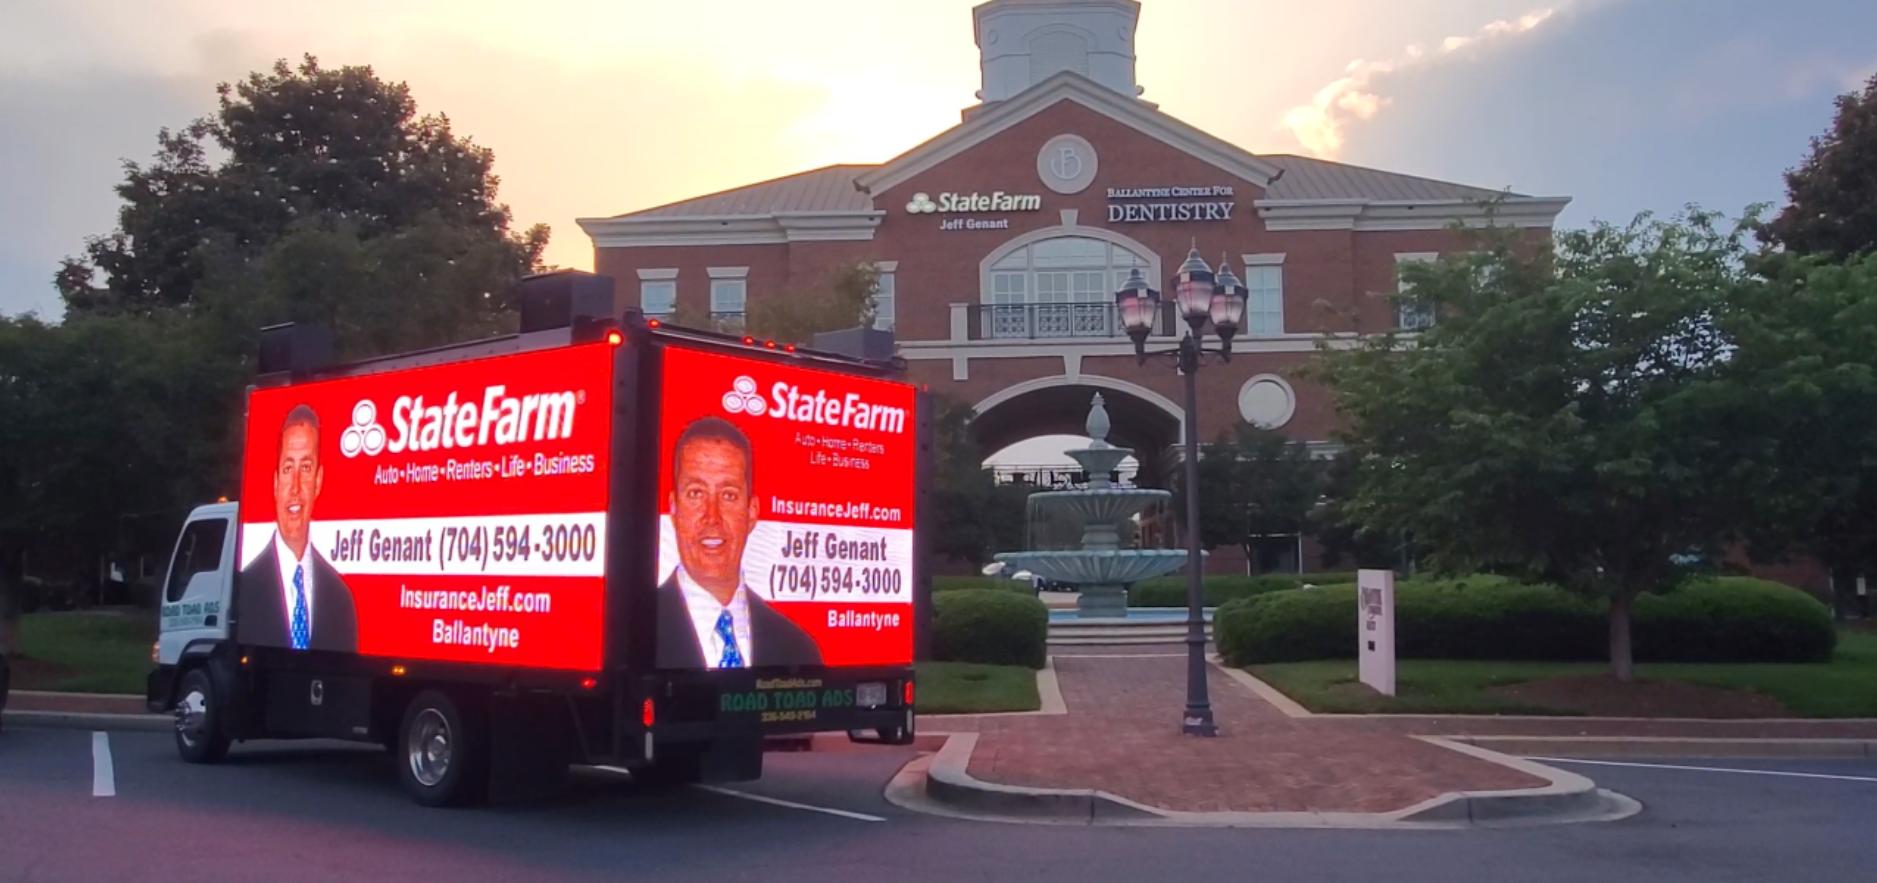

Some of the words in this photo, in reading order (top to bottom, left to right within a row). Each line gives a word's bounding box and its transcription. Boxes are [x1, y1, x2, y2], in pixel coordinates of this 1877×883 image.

[1107, 187, 1170, 198] BALLANTYNE
[1171, 186, 1212, 197] CENTER
[1213, 185, 1234, 196] FOR
[939, 219, 964, 230] Jeff
[966, 218, 1008, 229] Genant
[1108, 202, 1235, 222] DENTISTRY
[771, 496, 901, 521] InsuranceJeff.com
[330, 528, 363, 563] Jeff
[369, 528, 432, 562] Genant
[439, 526, 488, 571] (704)
[781, 530, 819, 559] Jeff
[825, 532, 887, 561] Genant
[769, 563, 817, 600] (704)
[400, 584, 551, 612] InsuranceJeff.com
[828, 609, 900, 631] Ballantyne
[432, 618, 520, 653] Ballantyne
[720, 692, 768, 712] ROAD
[775, 691, 817, 710] TOAD
[822, 689, 853, 708] ADS
